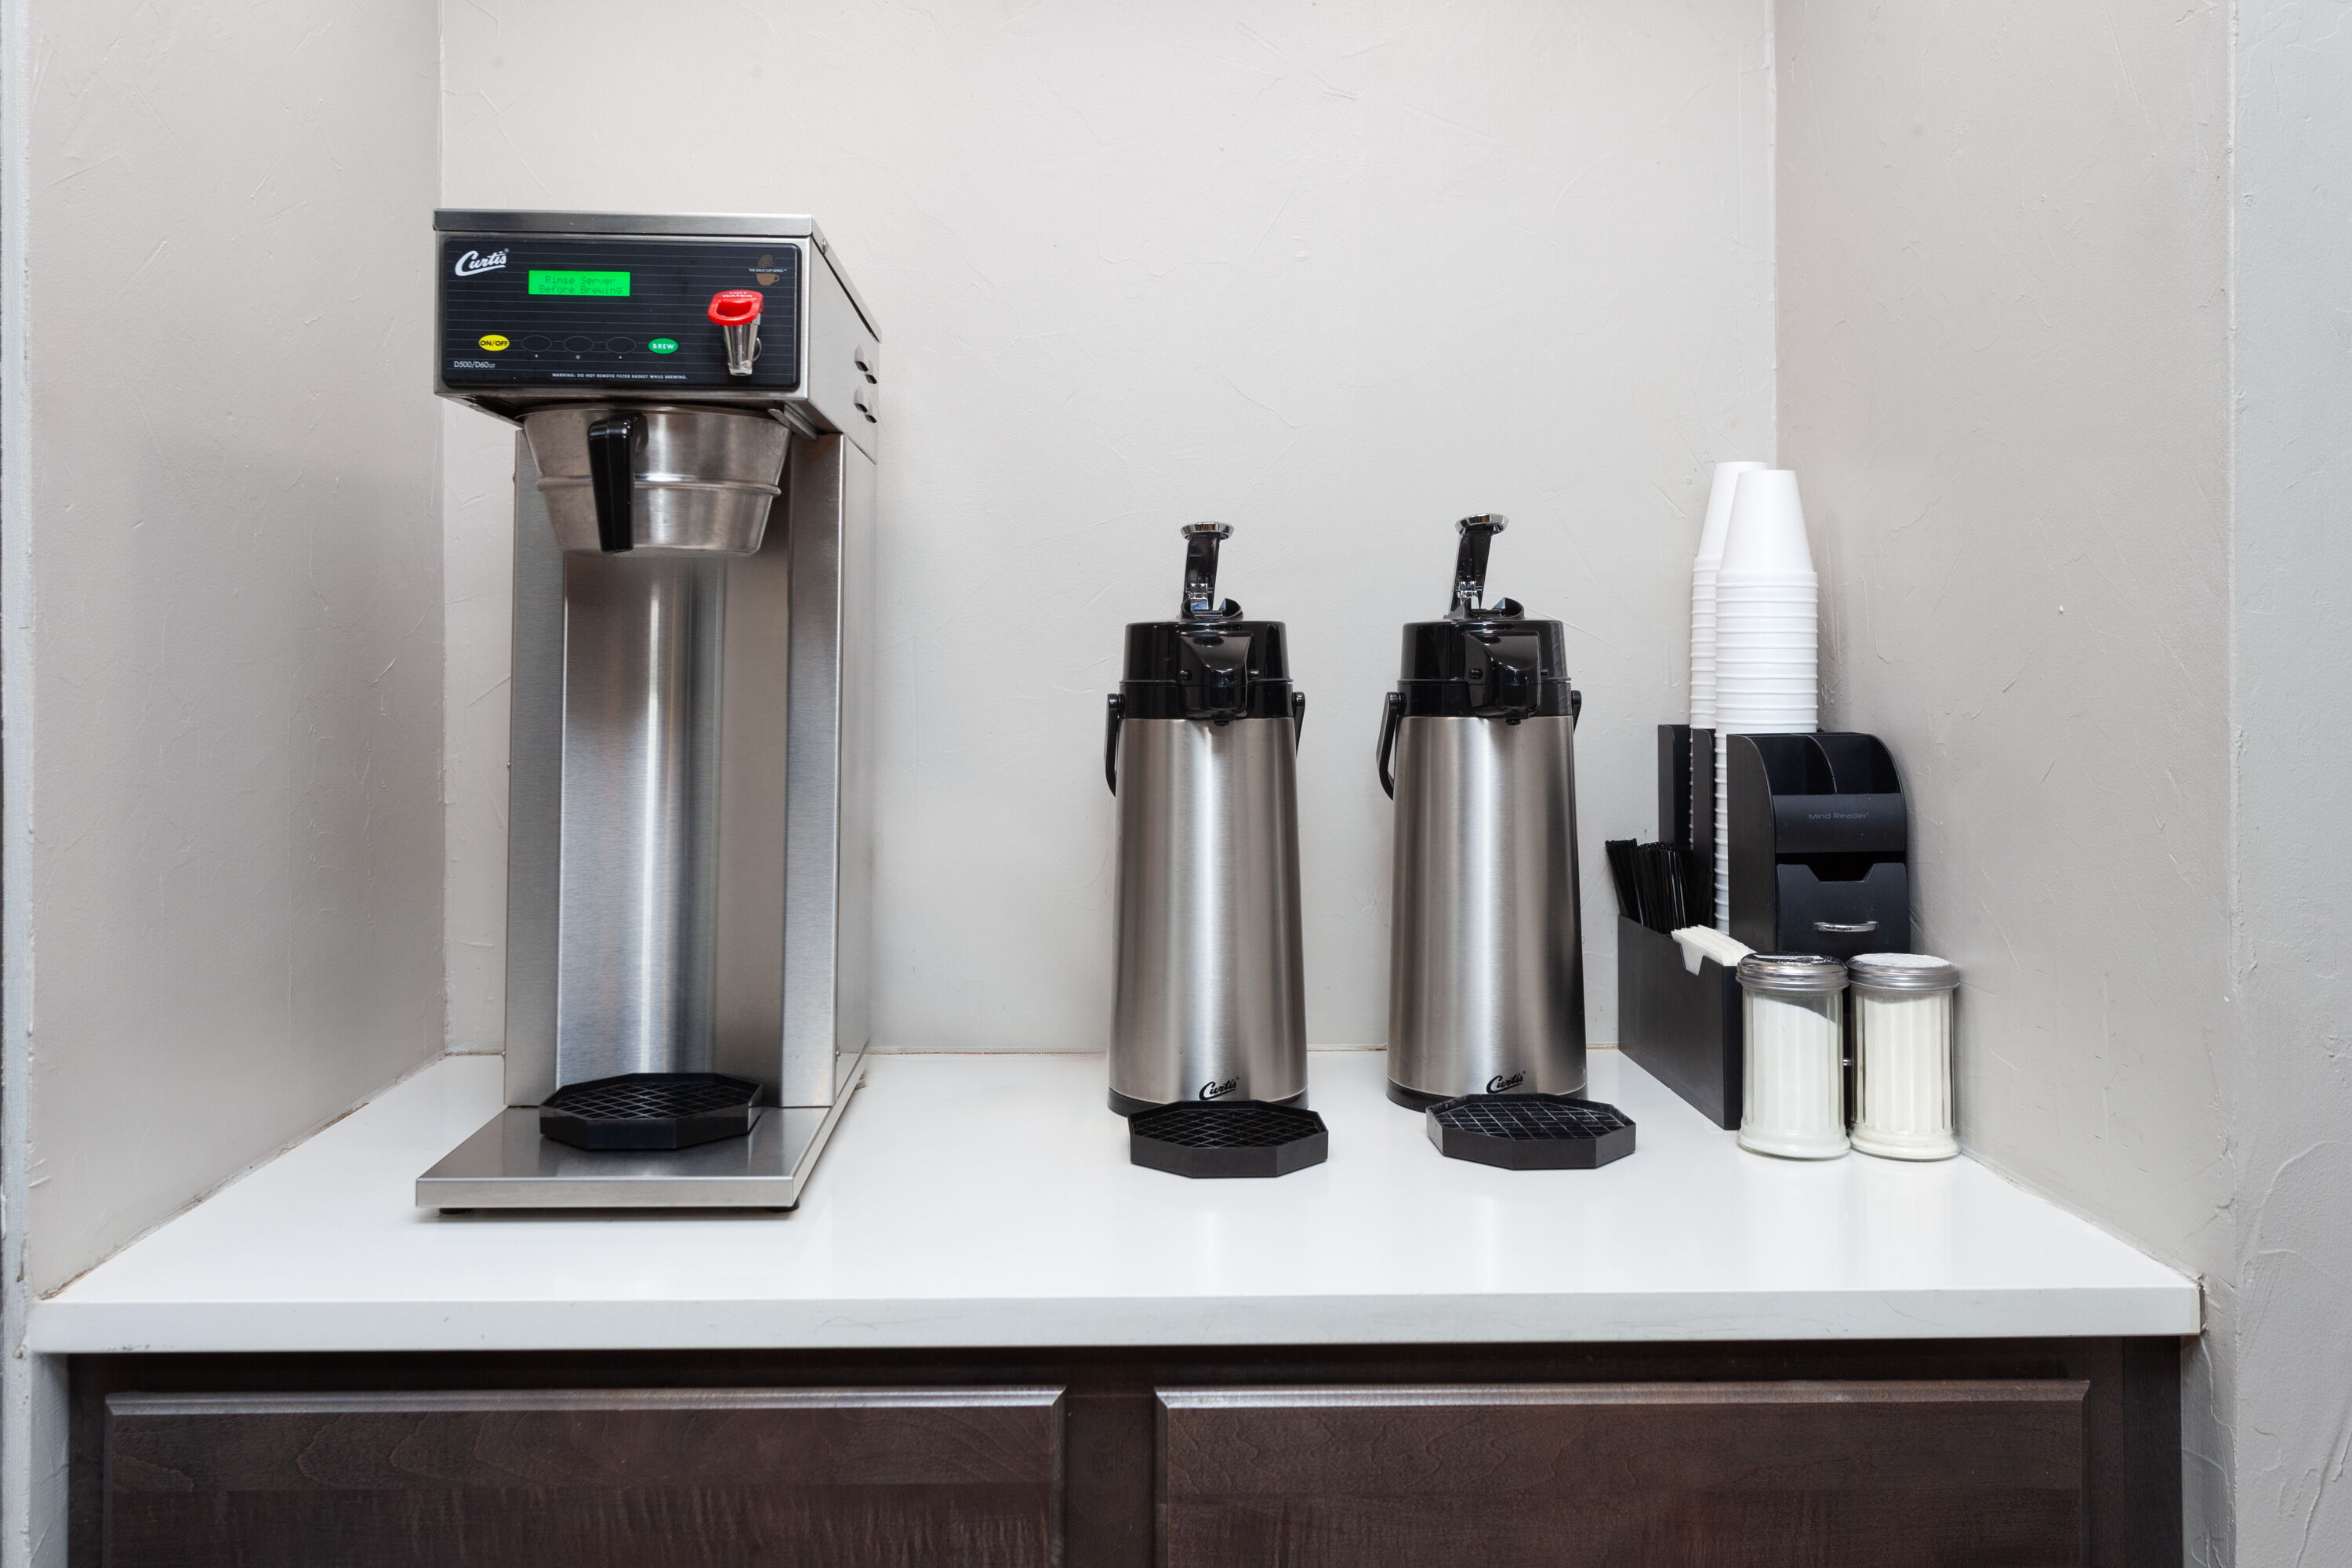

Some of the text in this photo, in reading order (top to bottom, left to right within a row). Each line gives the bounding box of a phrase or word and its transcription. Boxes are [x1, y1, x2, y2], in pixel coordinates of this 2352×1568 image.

[455, 249, 508, 276] Curtis
[539, 285, 622, 295] Before Brewing
[545, 275, 616, 285] Rinse Server
[1199, 1079, 1237, 1101] Curtis
[1486, 1072, 1524, 1094] Curtis
